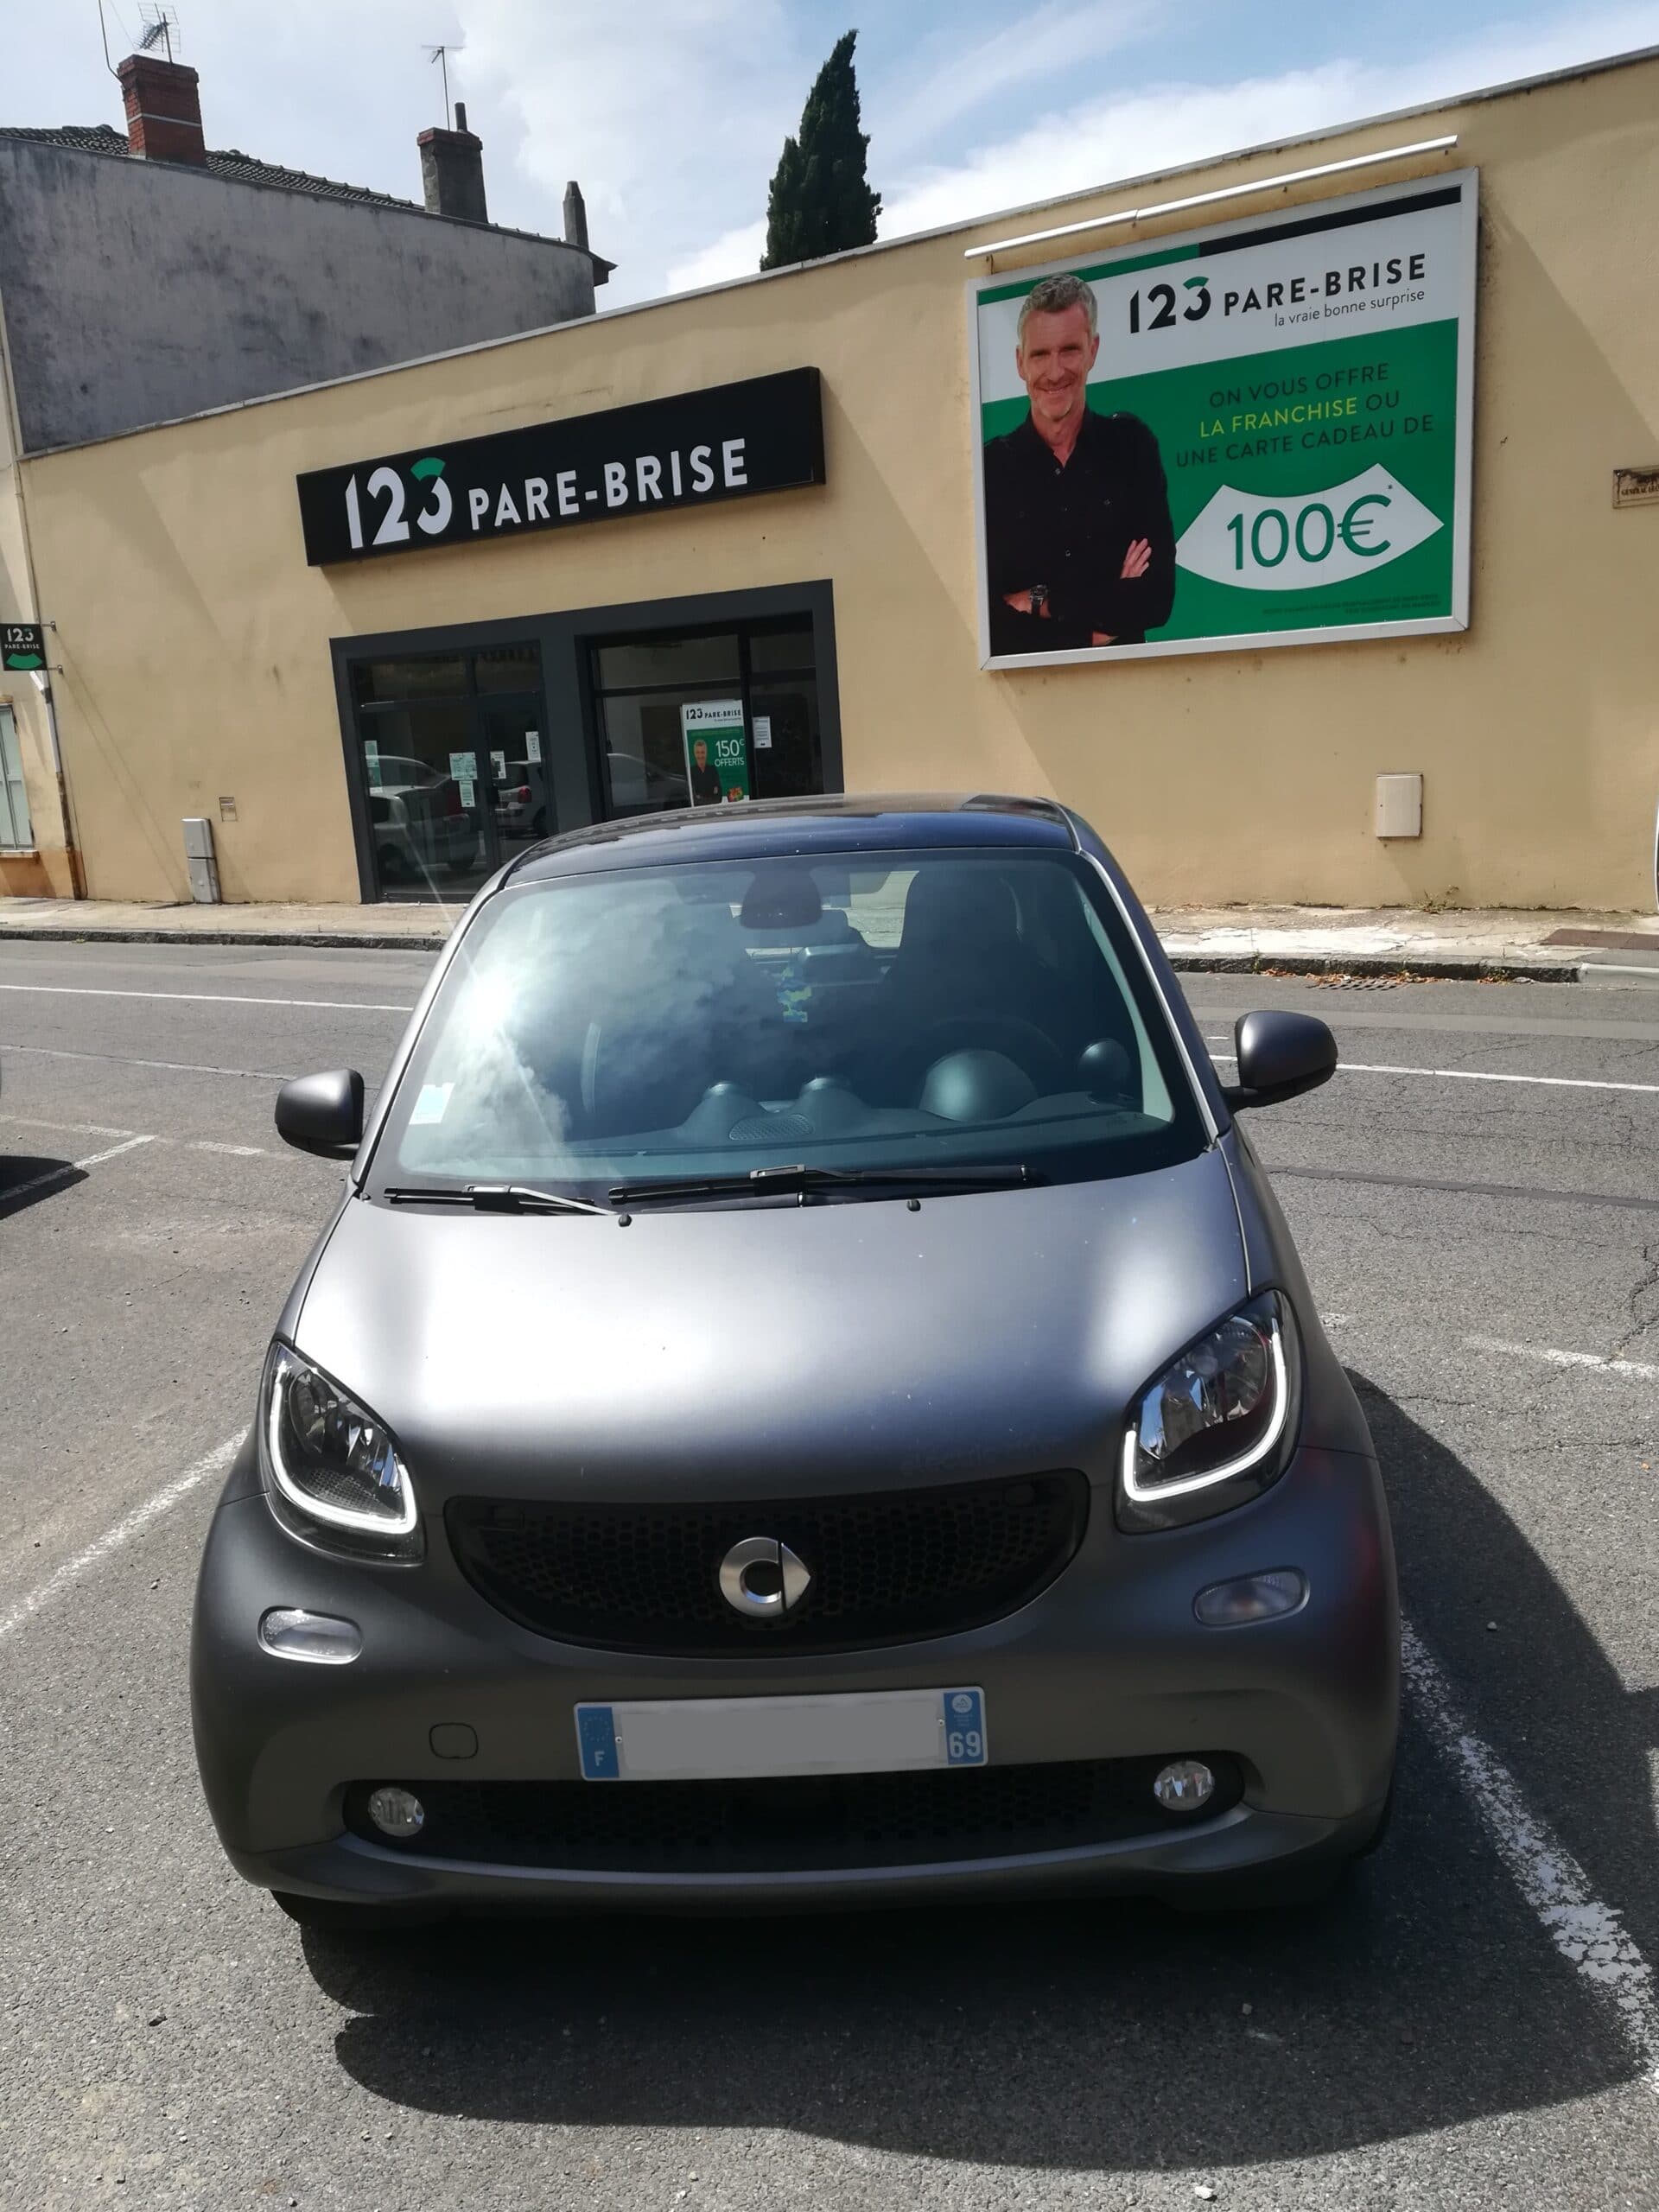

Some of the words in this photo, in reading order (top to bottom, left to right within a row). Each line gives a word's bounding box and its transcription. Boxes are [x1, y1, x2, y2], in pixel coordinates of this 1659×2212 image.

[1129, 276, 1211, 334] 123
[1224, 253, 1426, 316] PARE-BRISE
[1274, 313, 1286, 327] la
[1288, 307, 1320, 322] vraie
[1325, 301, 1366, 319] bonne
[1370, 288, 1426, 311] surprise
[1209, 387, 1241, 409] ON
[1249, 377, 1308, 402] VOUS
[1315, 362, 1389, 391] OFFRE
[1200, 418, 1225, 438] LA
[1231, 397, 1357, 433] FRANCHISE
[1365, 390, 1401, 411] OU
[1176, 447, 1218, 468] UNE
[1225, 435, 1294, 461] CARTE
[1301, 419, 1395, 449] CADEAU
[1403, 414, 1434, 435] DE
[345, 457, 453, 550] 123
[468, 438, 748, 531] PARE-BRISE
[7, 627, 34, 642] 123
[686, 708, 703, 720] 123
[715, 758, 745, 766] OFFERTS
[594, 1750, 605, 1767] F
[949, 1731, 981, 1758] 69
